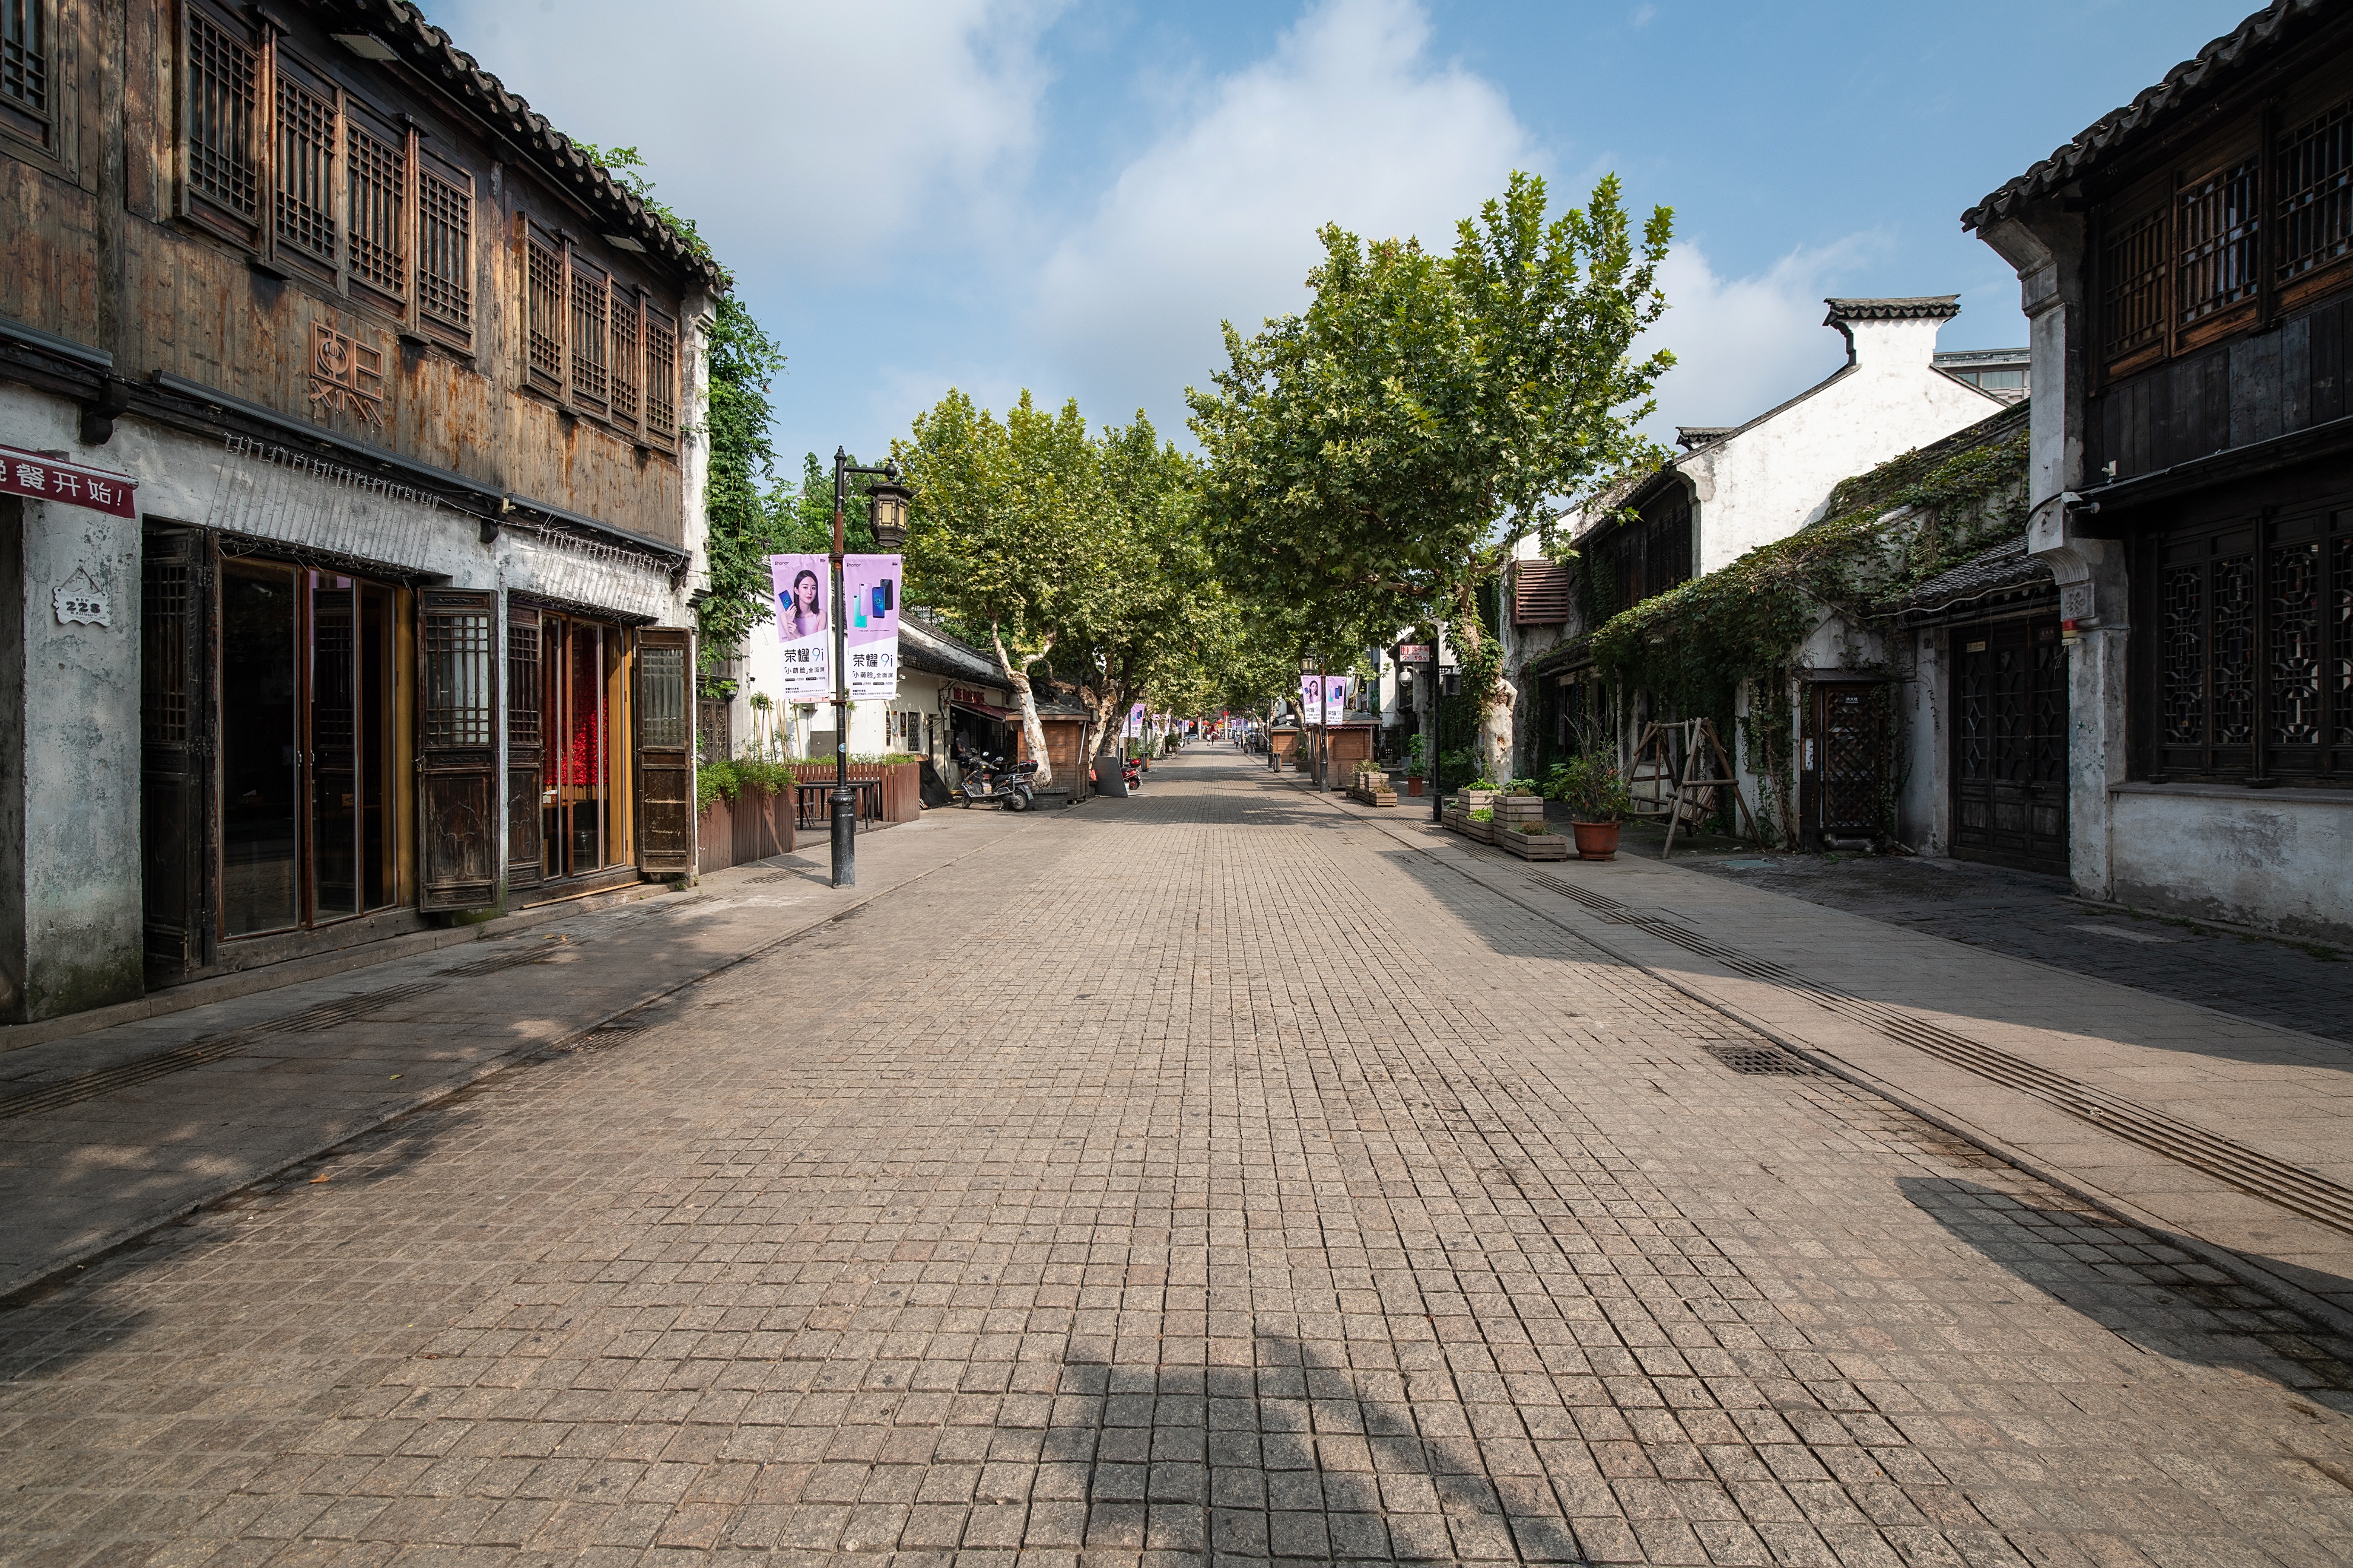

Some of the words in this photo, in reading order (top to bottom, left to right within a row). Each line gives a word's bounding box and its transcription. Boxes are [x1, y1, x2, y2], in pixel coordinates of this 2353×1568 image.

[66, 601, 101, 613] 228
[784, 648, 810, 663] 荣耀
[812, 647, 823, 661] 9i
[853, 653, 878, 667] 荣耀
[880, 653, 893, 667] 9i
